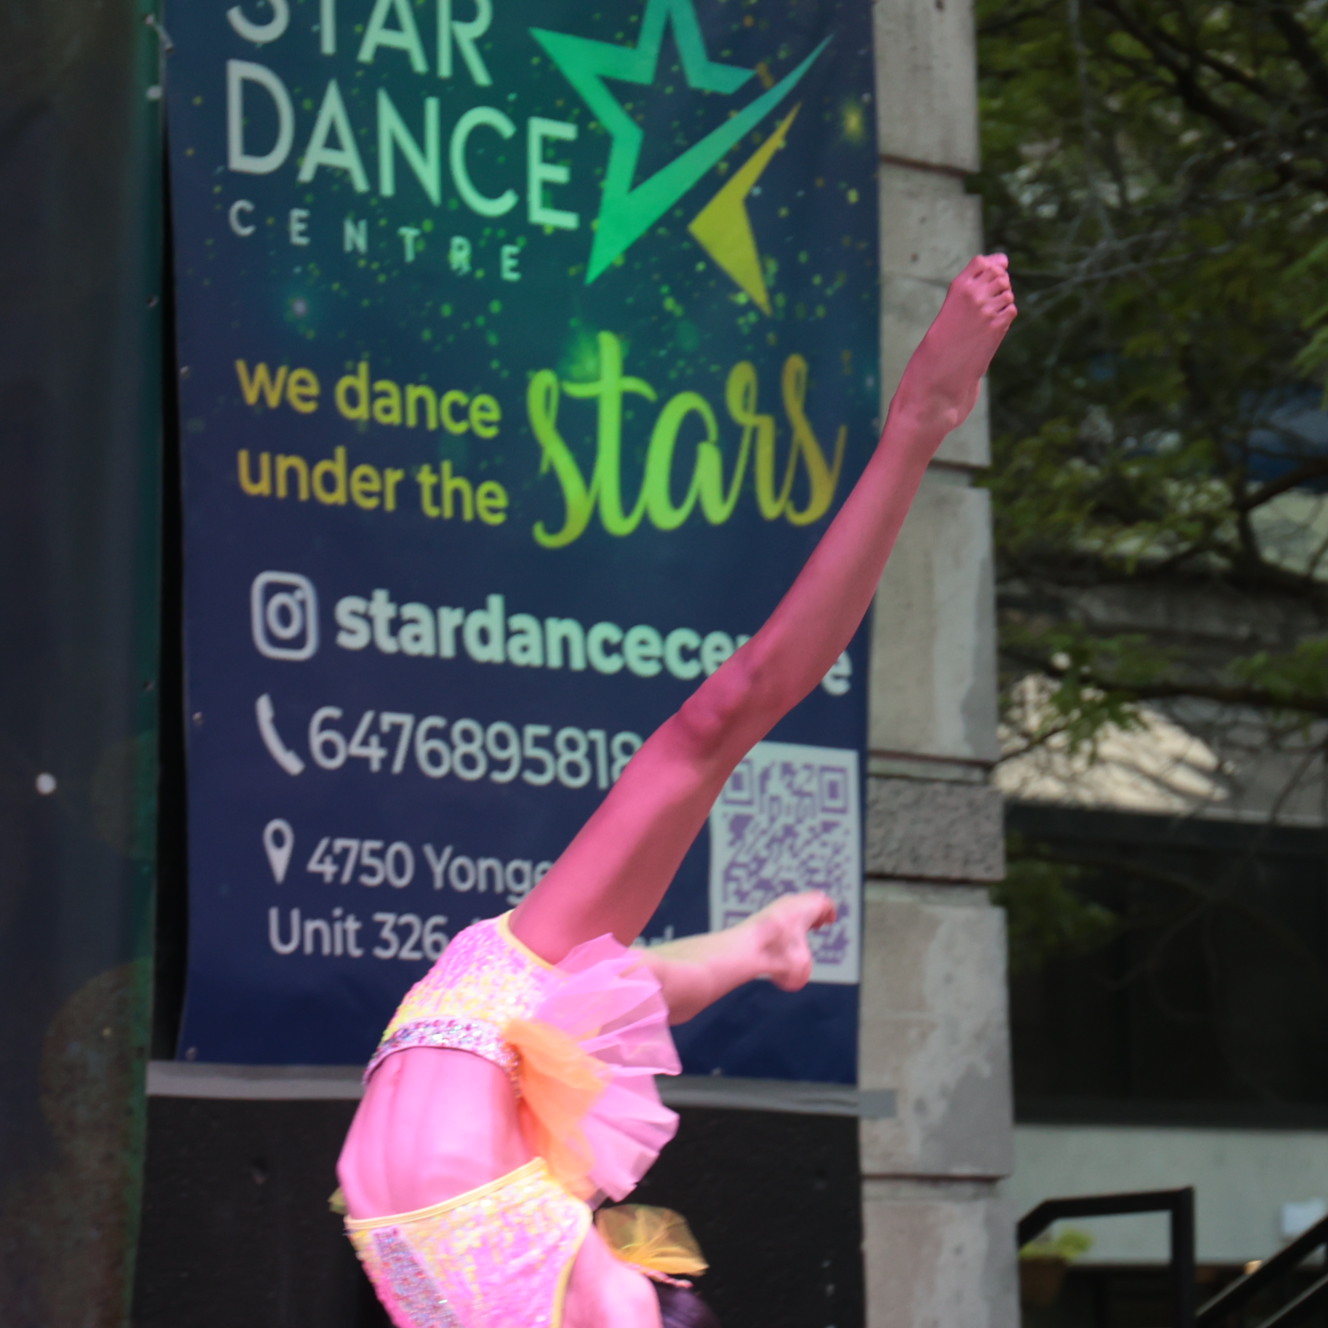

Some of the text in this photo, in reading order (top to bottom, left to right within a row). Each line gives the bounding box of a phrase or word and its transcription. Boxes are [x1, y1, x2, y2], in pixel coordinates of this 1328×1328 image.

[226, 59, 579, 230] DANCE
[229, 200, 521, 281] CENTRE
[235, 359, 501, 438] we dance
[527, 330, 847, 548] stars
[237, 447, 508, 524] under the
[334, 590, 852, 695] stardancecee
[307, 837, 414, 888] 4750
[268, 906, 363, 957] Unit
[371, 912, 451, 962] 326
